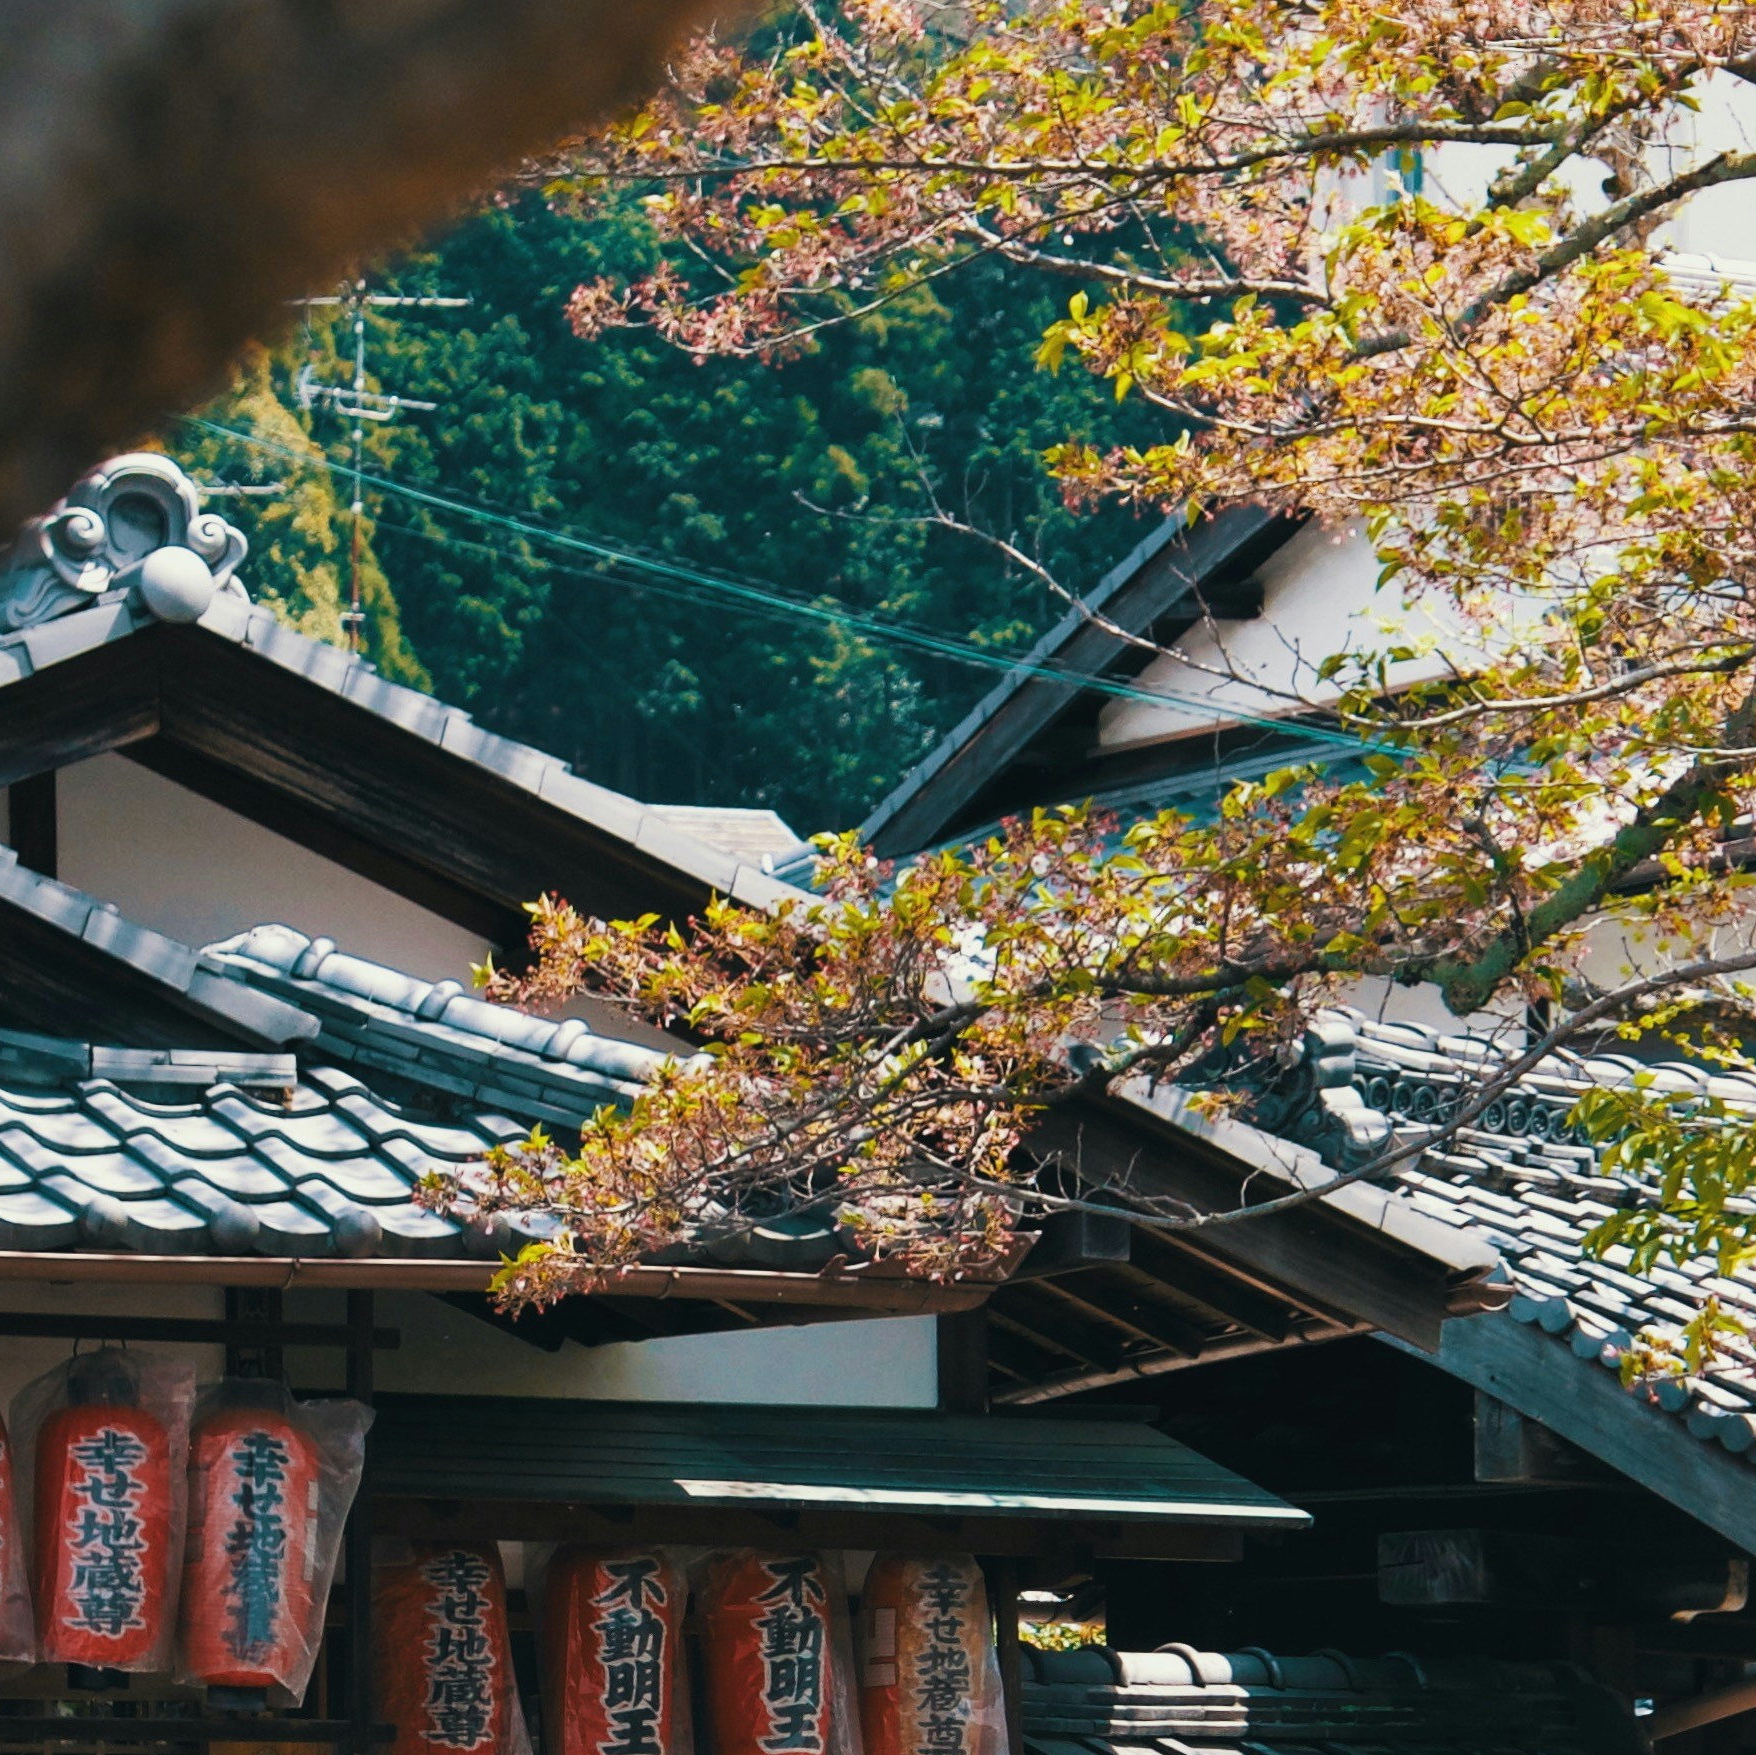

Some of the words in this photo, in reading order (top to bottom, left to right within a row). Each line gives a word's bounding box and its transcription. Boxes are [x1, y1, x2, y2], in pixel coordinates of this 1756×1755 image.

[64, 1430, 147, 1639] 幸せ地蔵尊
[419, 1552, 496, 1750] 幸せ地蔵尊
